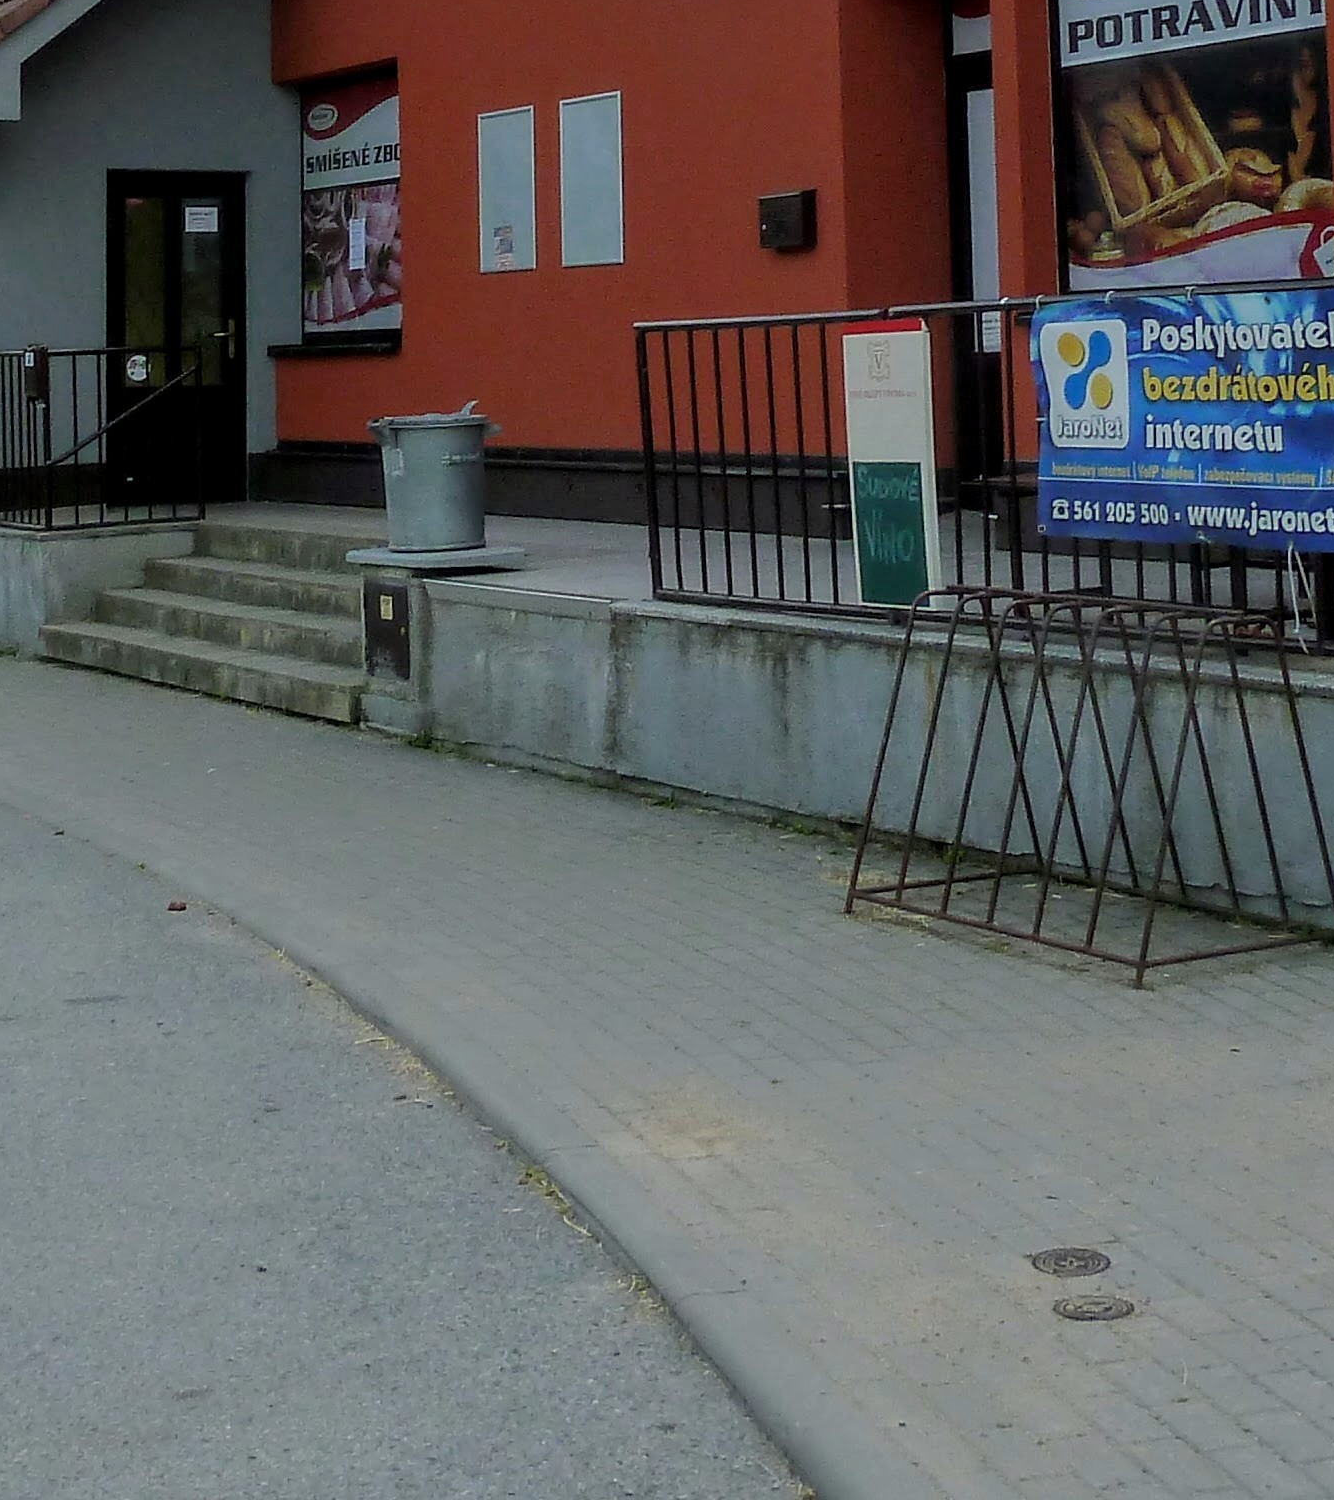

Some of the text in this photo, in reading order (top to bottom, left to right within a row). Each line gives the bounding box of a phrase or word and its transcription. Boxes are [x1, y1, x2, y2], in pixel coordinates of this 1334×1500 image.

[306, 142, 371, 174] SMÍŠENÉ
[1057, 414, 1124, 440] JaroNet
[1145, 413, 1285, 452] internetu
[1073, 500, 1100, 521] 561
[1105, 501, 1136, 524] 205
[1140, 502, 1169, 526] 500
